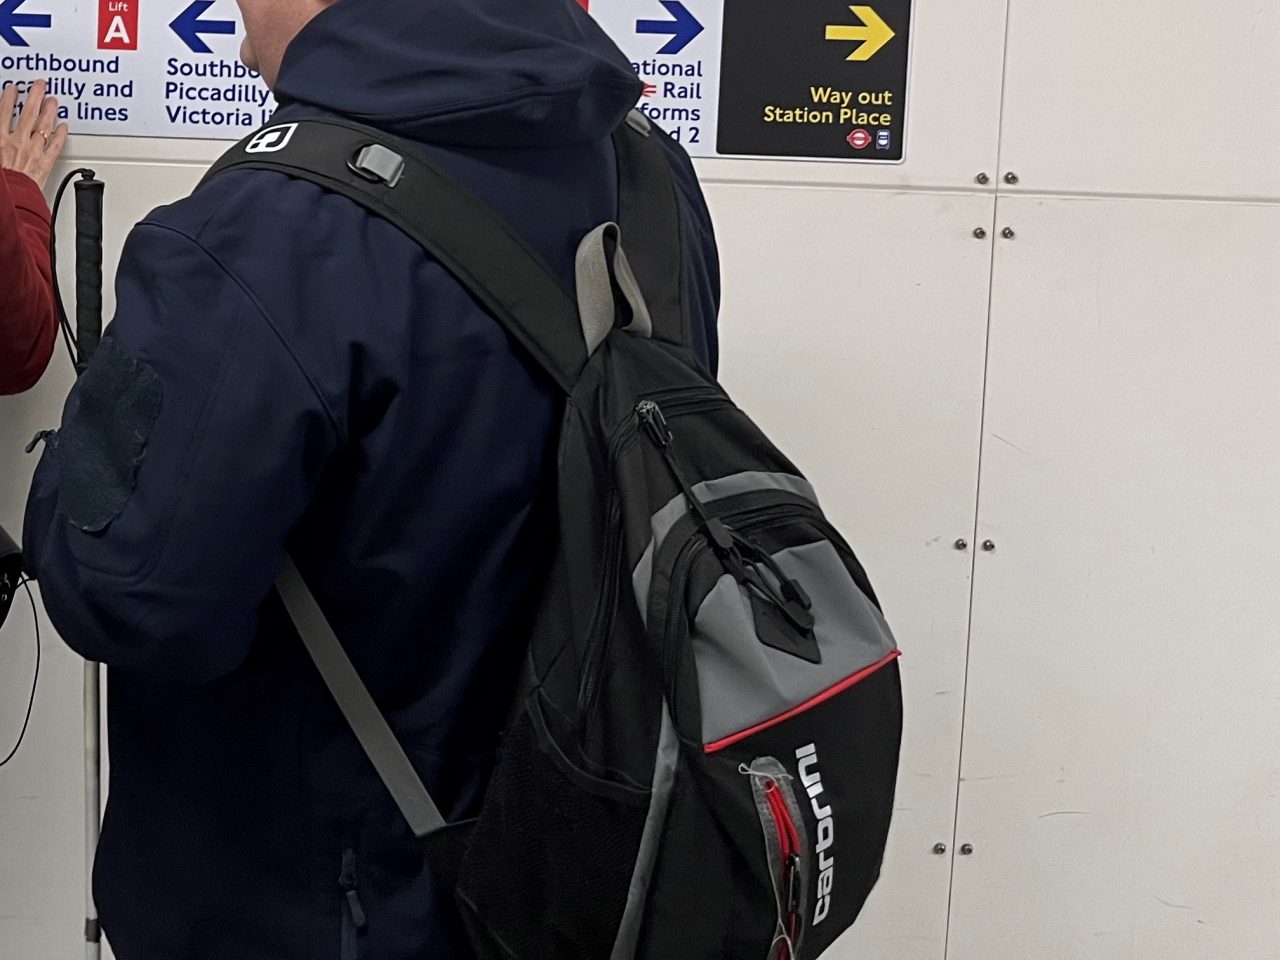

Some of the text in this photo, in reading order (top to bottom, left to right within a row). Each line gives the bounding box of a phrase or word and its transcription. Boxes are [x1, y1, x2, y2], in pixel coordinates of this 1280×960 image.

[108, 1, 128, 12] Lift
[103, 15, 130, 44] A
[166, 57, 261, 79] Southbo
[631, 58, 703, 77] ational
[92, 79, 133, 98] and
[165, 81, 270, 107] Piccadilly
[663, 81, 702, 100] Rail
[809, 86, 893, 107] Way out
[77, 101, 129, 122] lines
[165, 105, 253, 126] Victoria
[636, 102, 701, 121] forms
[763, 105, 891, 125] Station Place
[688, 126, 700, 144] 2
